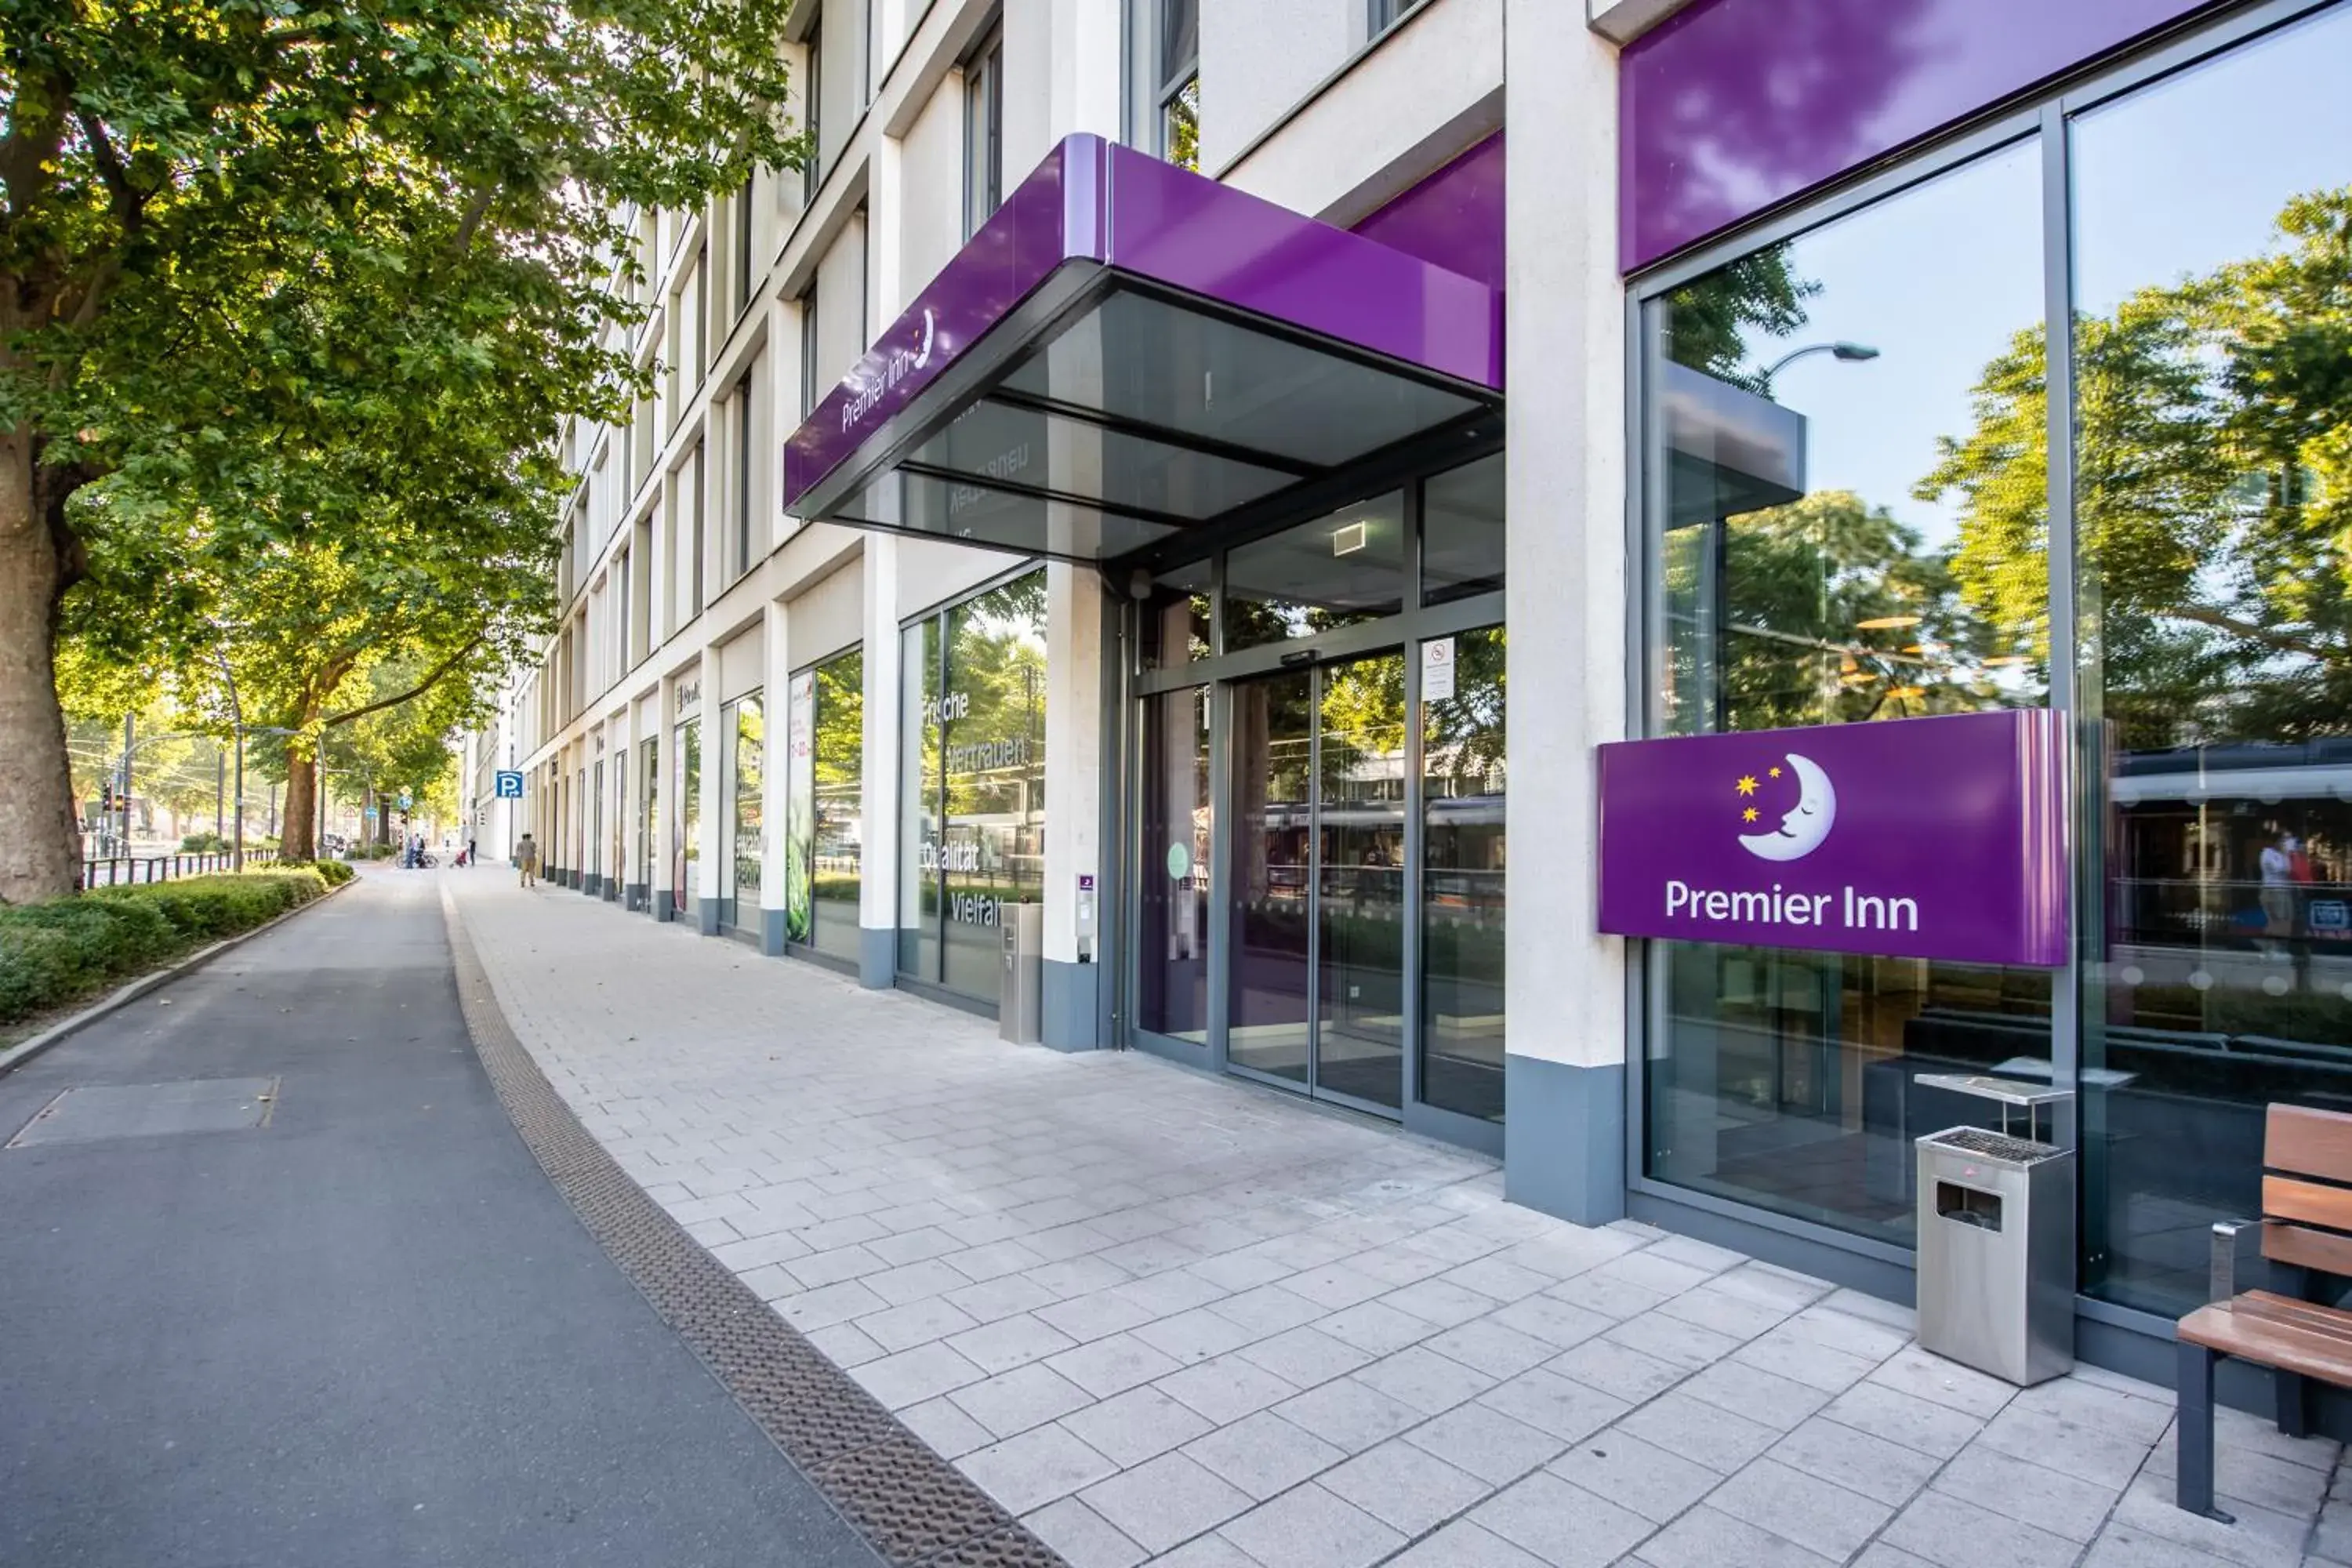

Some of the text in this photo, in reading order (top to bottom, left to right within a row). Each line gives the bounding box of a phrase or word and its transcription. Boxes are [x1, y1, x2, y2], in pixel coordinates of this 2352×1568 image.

[843, 350, 908, 433] Premier Inn
[502, 777, 517, 796] P
[950, 891, 1003, 927] Vielfal
[1666, 880, 1918, 931] Premier Inn
